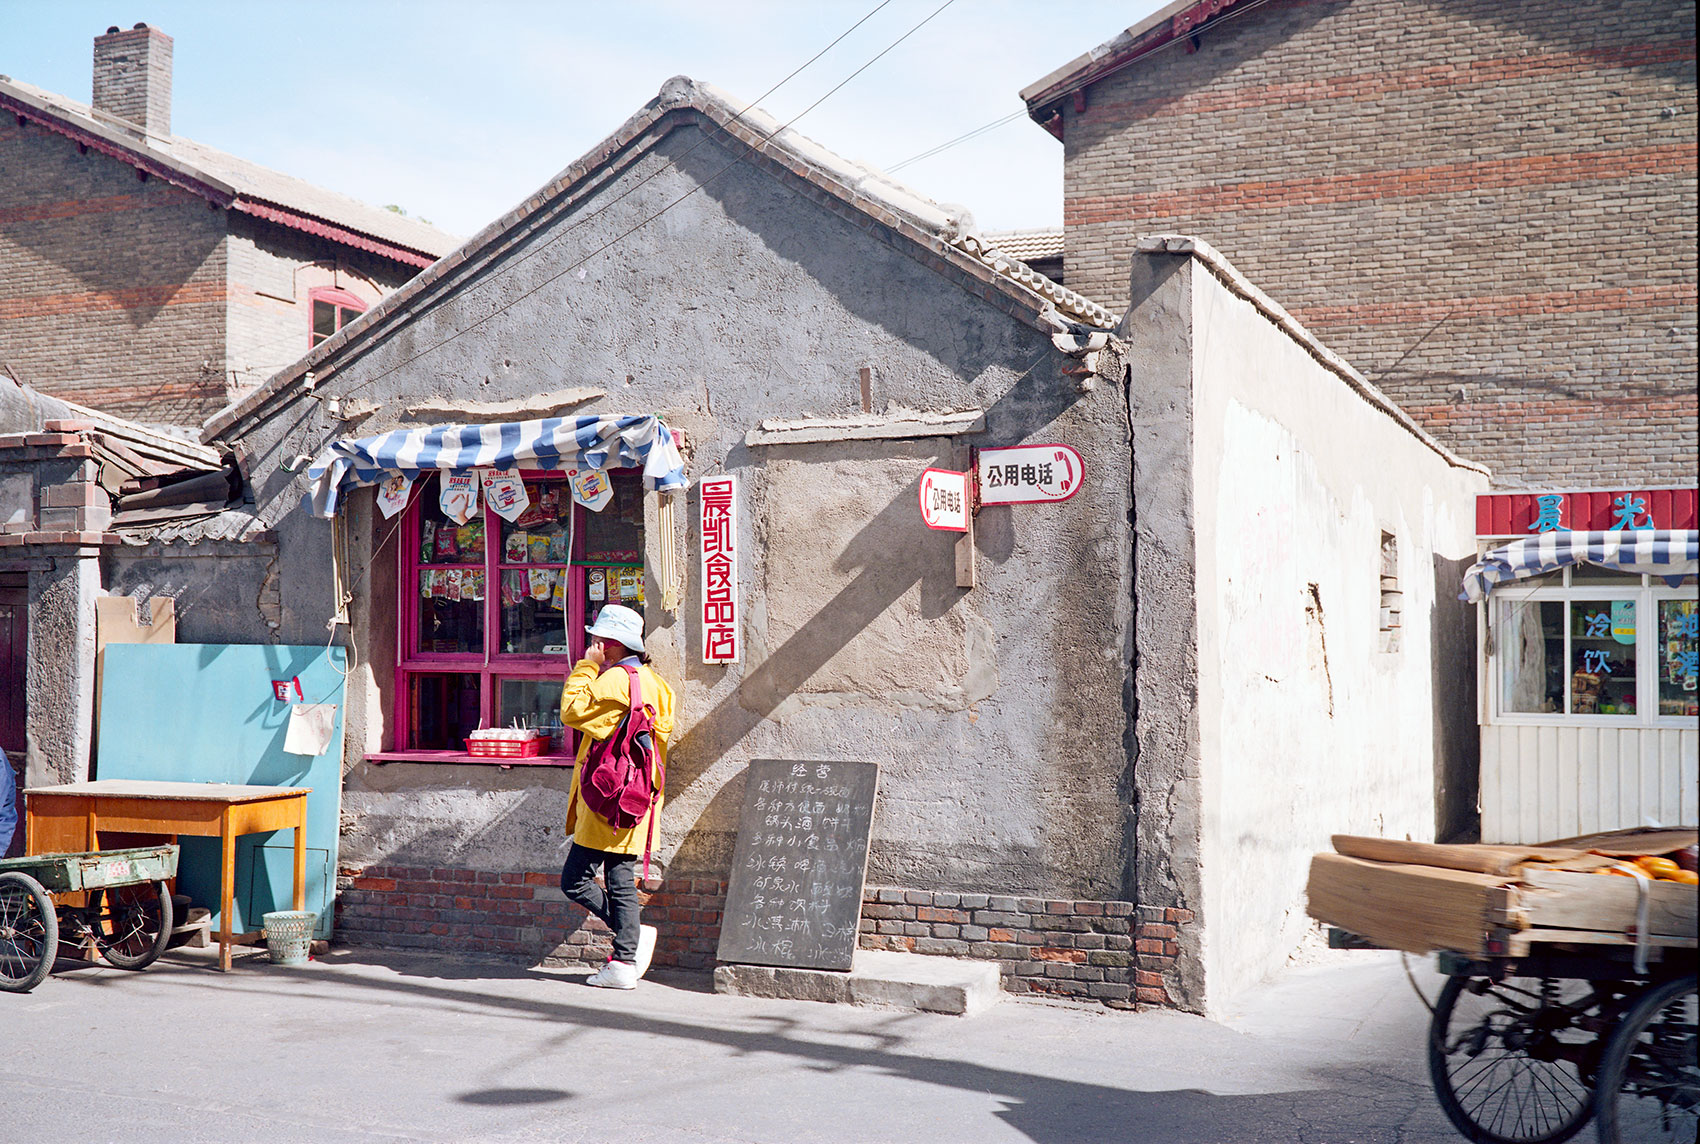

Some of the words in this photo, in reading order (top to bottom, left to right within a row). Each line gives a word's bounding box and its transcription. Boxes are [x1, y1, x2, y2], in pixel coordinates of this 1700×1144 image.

[987, 462, 1054, 488] 公用电话
[933, 487, 961, 513] 公用电话
[1528, 493, 1656, 532] 晨光
[702, 481, 735, 660] 晨凯食品店
[1584, 613, 1613, 674] 冷饮
[790, 763, 831, 779] 经营
[753, 797, 826, 815] 各种方便面
[753, 875, 800, 893] 矿泉水
[746, 936, 796, 960] 冰棍
